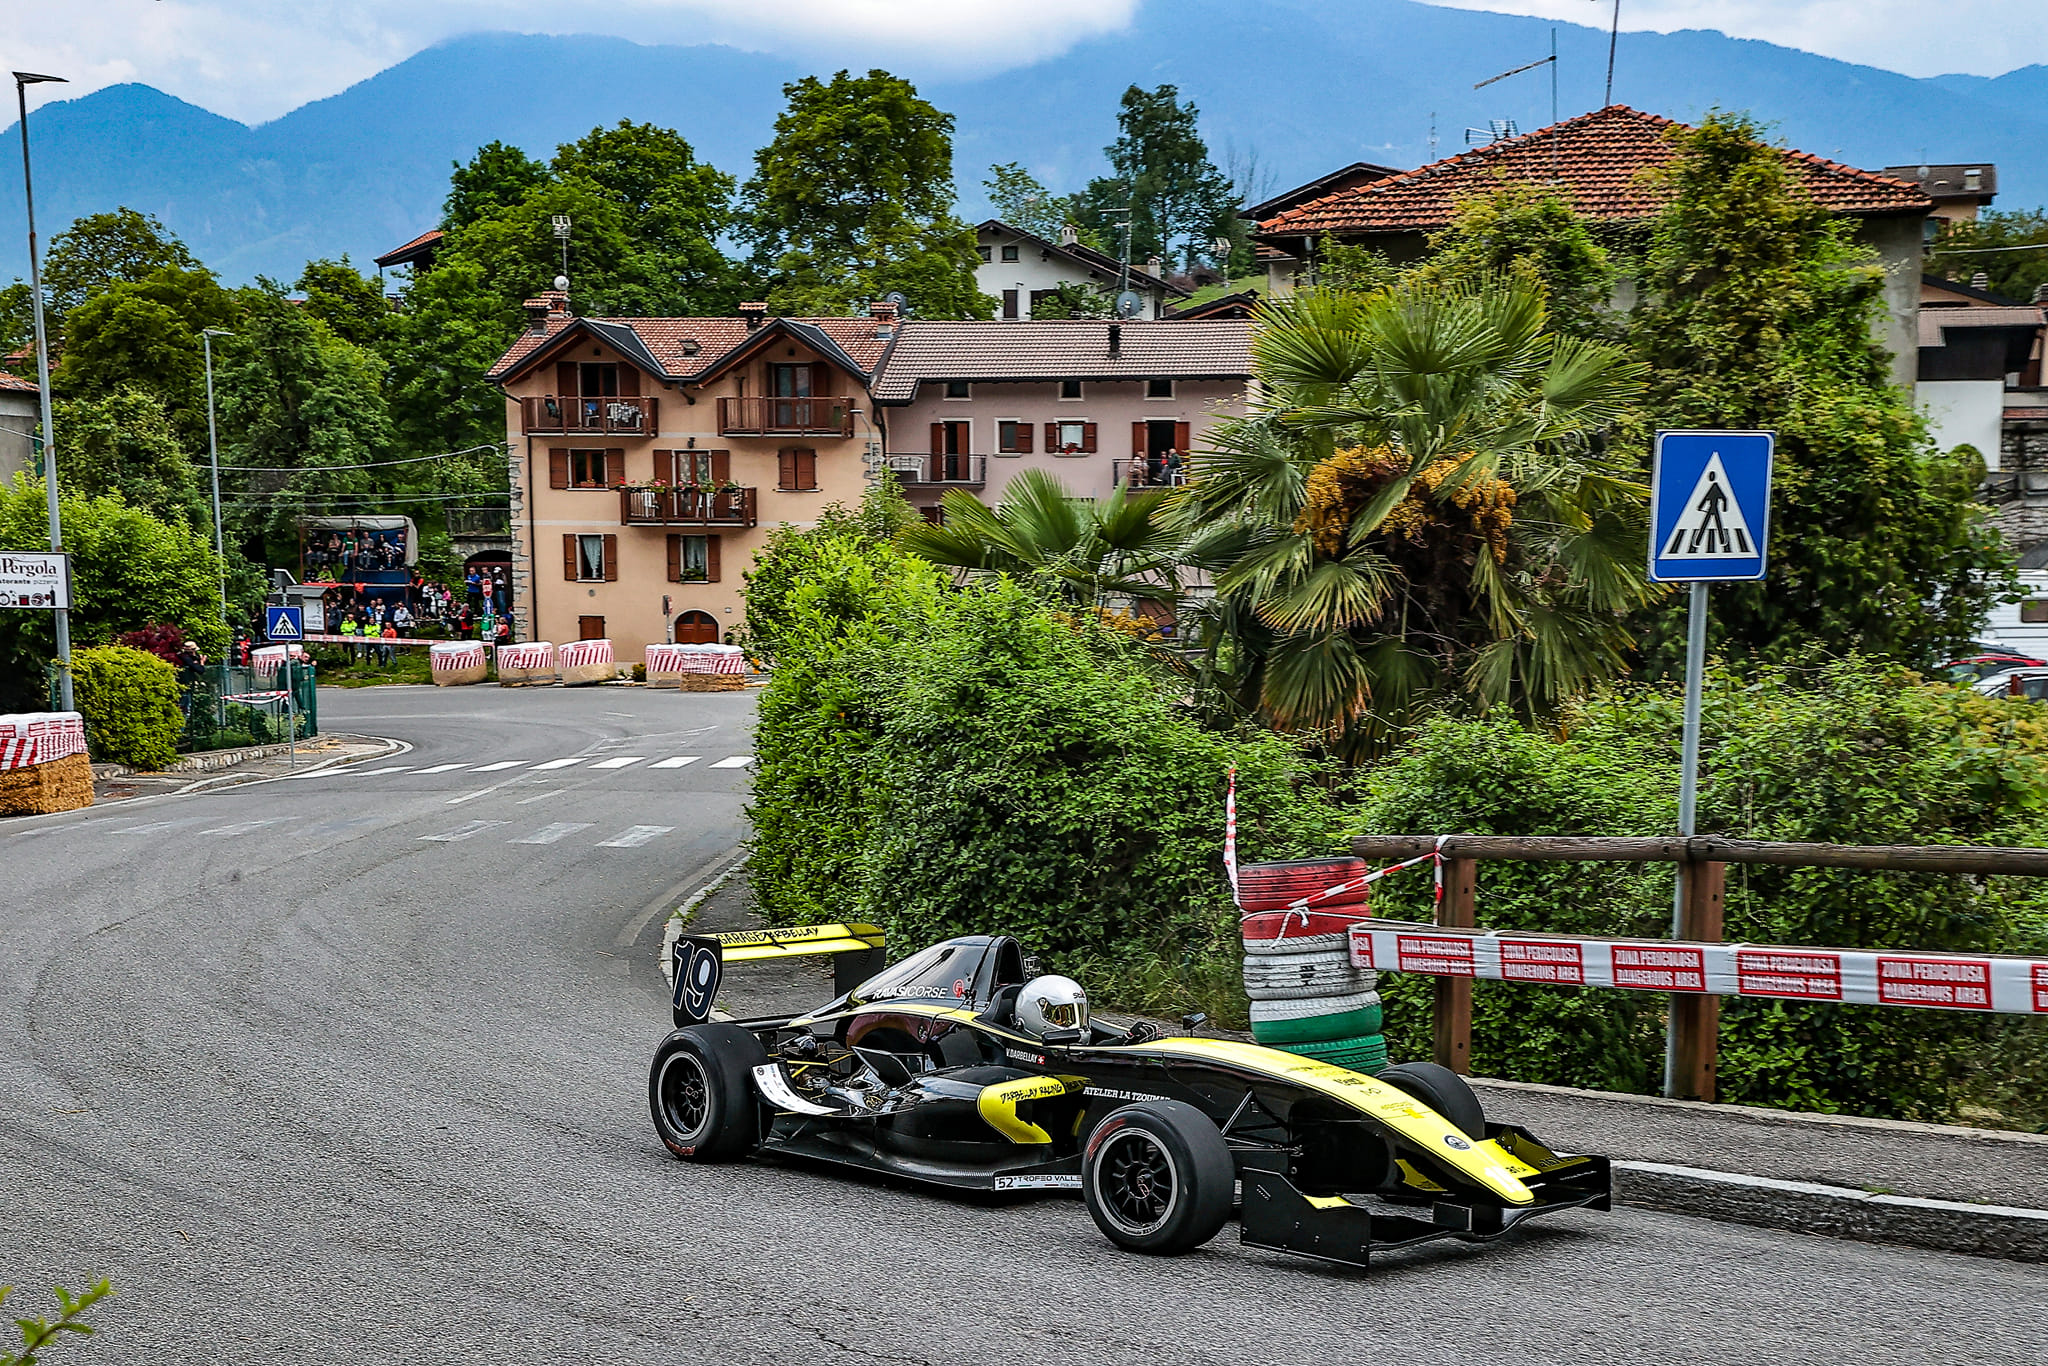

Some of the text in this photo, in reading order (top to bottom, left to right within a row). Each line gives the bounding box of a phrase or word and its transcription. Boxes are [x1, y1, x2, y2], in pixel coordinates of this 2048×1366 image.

[1, 557, 57, 577] Pergola
[716, 931, 762, 945] GARAGE
[1615, 949, 1700, 968] ZONA PERICOLOSA
[672, 938, 718, 1020] 19
[1616, 969, 1702, 988] DANGEROUS AREA
[1881, 961, 1986, 983] ZONA PERICOLOSA
[1883, 982, 1987, 1004] DANGEROUS AREA
[1083, 1086, 1118, 1099] ATELIER
[1119, 1090, 1131, 1100] LA
